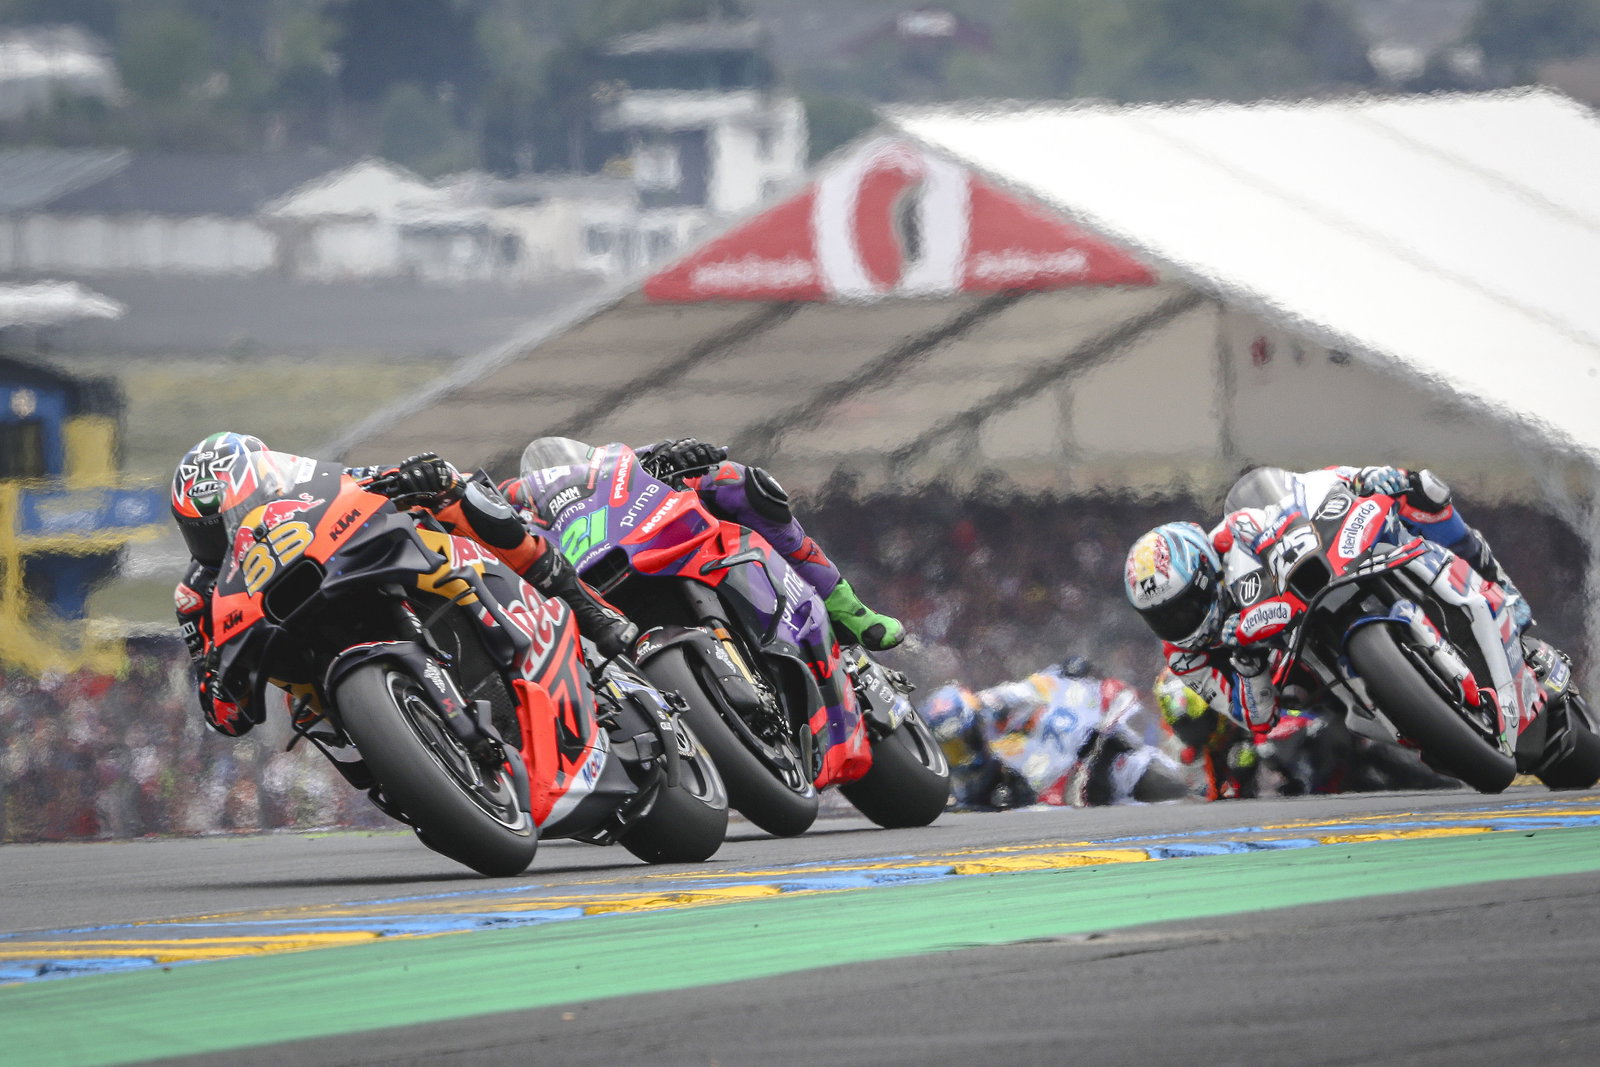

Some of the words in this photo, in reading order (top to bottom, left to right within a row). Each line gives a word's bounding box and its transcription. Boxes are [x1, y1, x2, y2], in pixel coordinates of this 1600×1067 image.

[613, 454, 632, 499] PRAMAC
[549, 486, 581, 517] FIAMM
[556, 502, 586, 532] prima
[620, 484, 660, 528] prima
[641, 496, 680, 534] MOTUL
[329, 509, 361, 541] KTM
[560, 505, 609, 566] 21
[1343, 503, 1376, 556] sterilgarda
[242, 520, 315, 598] 33
[223, 609, 244, 634] KTM
[1242, 603, 1289, 633] sterilgarda
